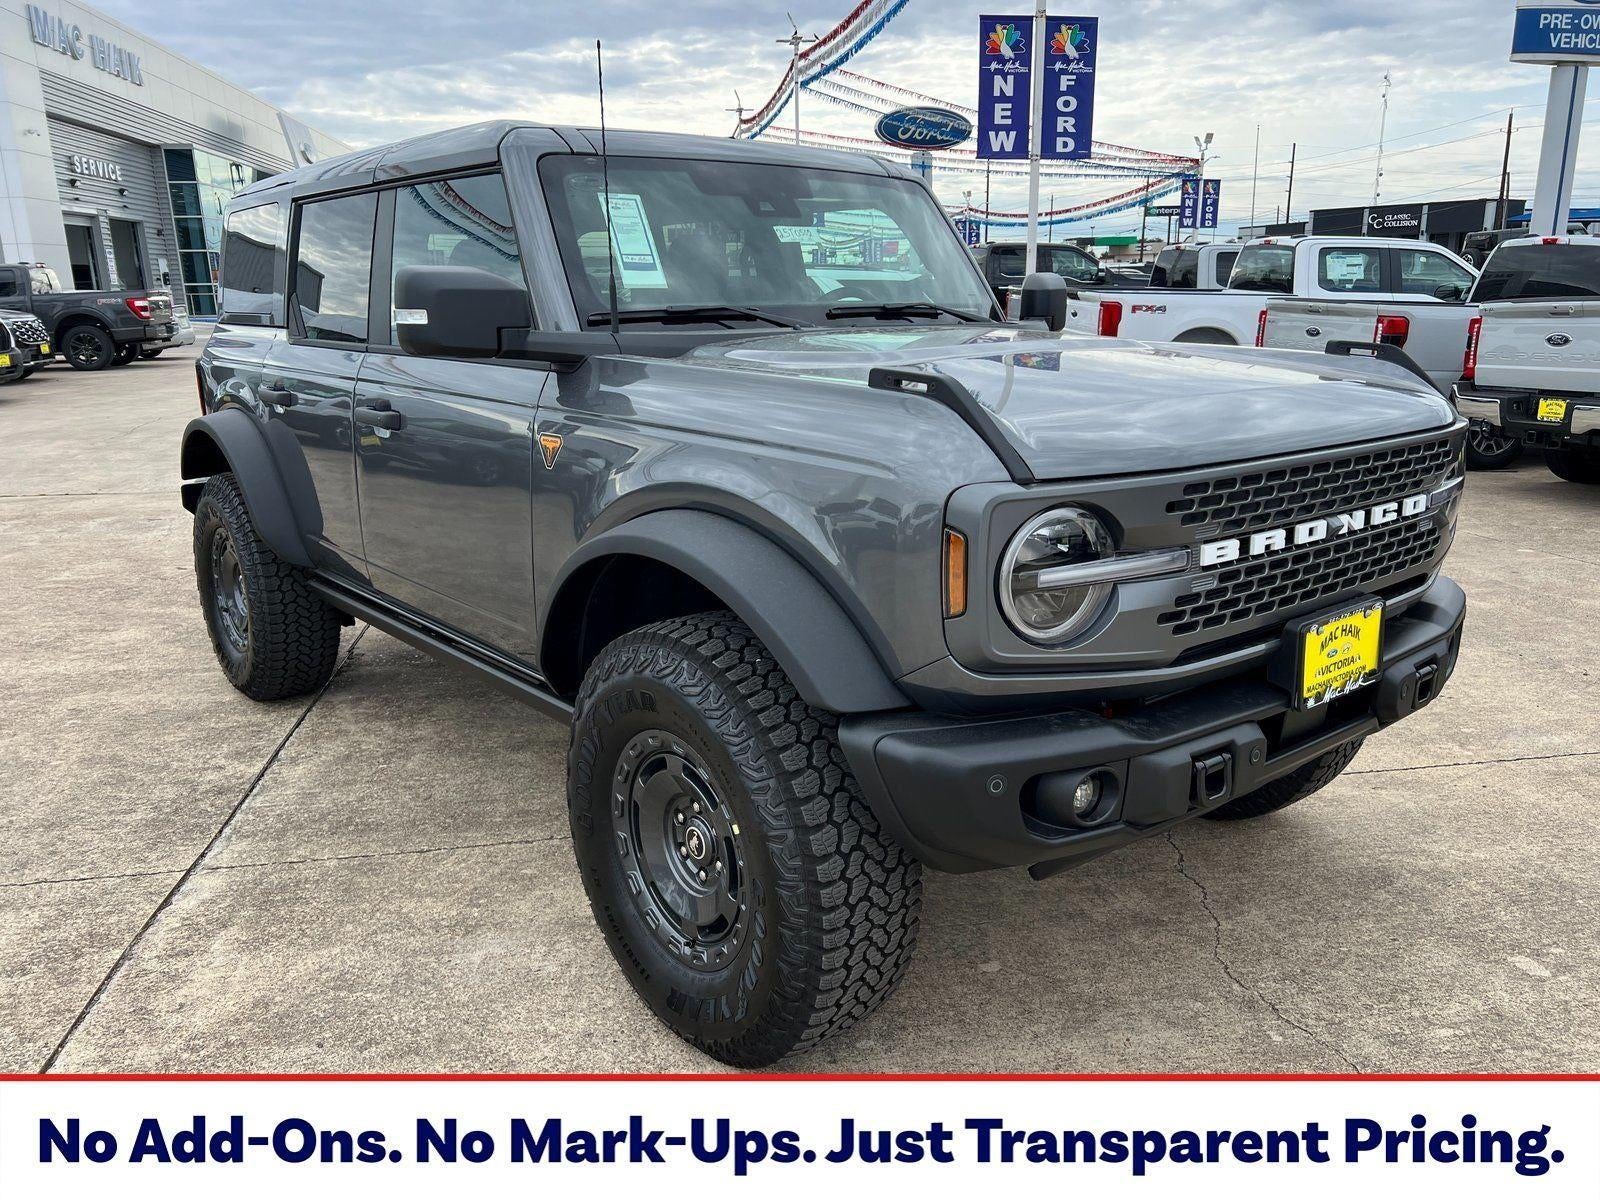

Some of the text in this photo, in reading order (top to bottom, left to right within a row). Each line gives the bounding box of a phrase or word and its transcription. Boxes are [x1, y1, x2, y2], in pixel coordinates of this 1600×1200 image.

[25, 4, 144, 87] MAC HAIK
[898, 114, 953, 141] Ford
[988, 74, 1017, 152] NEW
[1056, 74, 1078, 153] FORD
[73, 155, 123, 181] SERVICE
[1182, 198, 1194, 227] NEW
[1204, 198, 1214, 227] FORD
[1384, 213, 1411, 221] CLASSIC
[1384, 219, 1419, 228] COLLISION
[1131, 303, 1168, 315] FX4
[1200, 493, 1427, 567] BRONCO
[1319, 623, 1361, 654] MAC HAIK
[1320, 657, 1356, 677] VICTORIA
